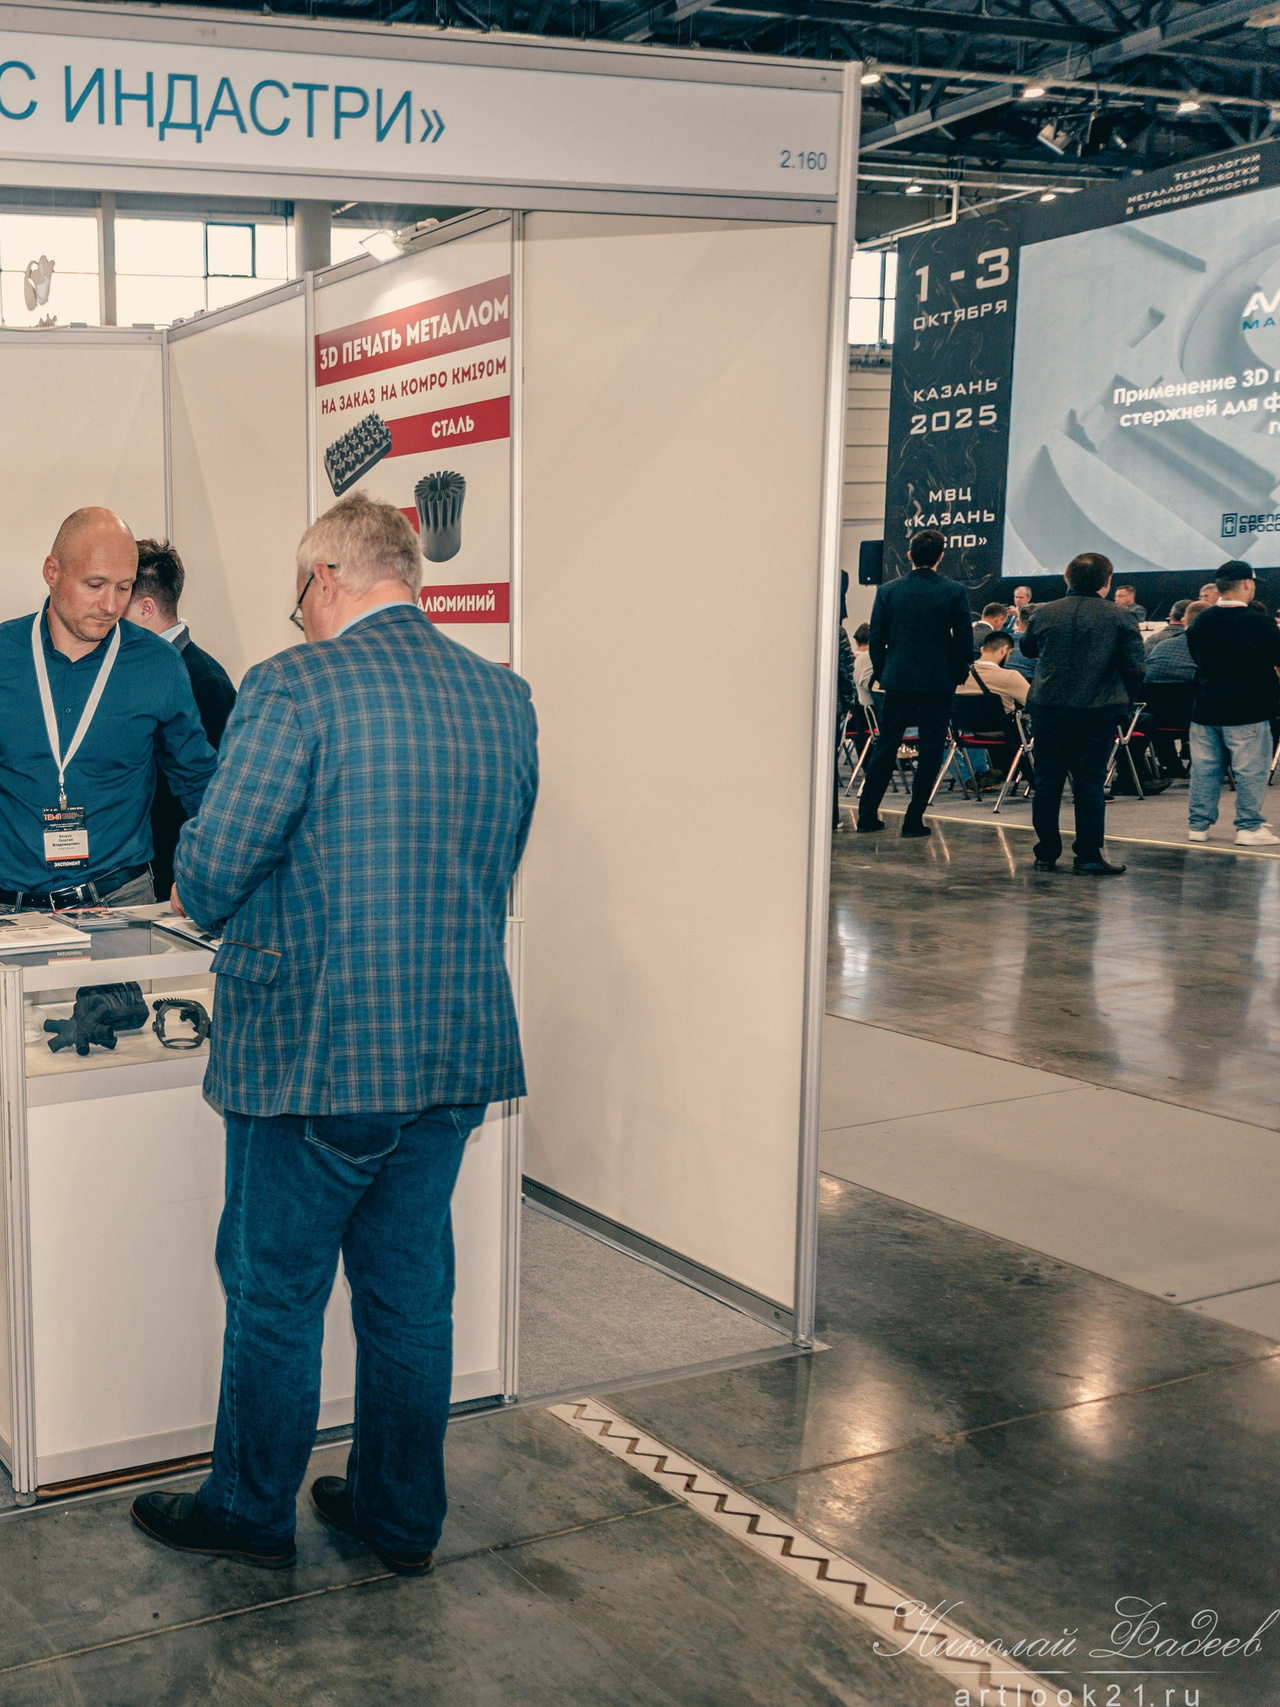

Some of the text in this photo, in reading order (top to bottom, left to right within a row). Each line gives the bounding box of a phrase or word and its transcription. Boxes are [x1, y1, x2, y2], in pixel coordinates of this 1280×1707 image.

[64, 65, 446, 145] ИНДАСТРИ»
[780, 149, 827, 171] 2.160
[1174, 153, 1261, 181] ТЕХНОЛОГИИ
[913, 299, 1008, 330] ОКТЯБРЯ
[320, 294, 509, 371] 3D ПЕЧАТЬ МЕТАЛЛОМ
[322, 397, 337, 415] НА
[339, 388, 376, 411] ЗАКАЗ
[381, 383, 397, 402] НА
[913, 378, 998, 403] КАЗАНЬ
[1113, 375, 1238, 406] Применение
[1241, 368, 1269, 388] 3D
[910, 404, 998, 435] 2025
[1119, 398, 1218, 427] стержней
[1221, 398, 1259, 417] для
[431, 415, 475, 439] СТАЛЬ
[928, 487, 972, 503] МВЦ
[904, 510, 995, 527] «КАЗАНЬ
[1239, 513, 1280, 524] СДЕЛА
